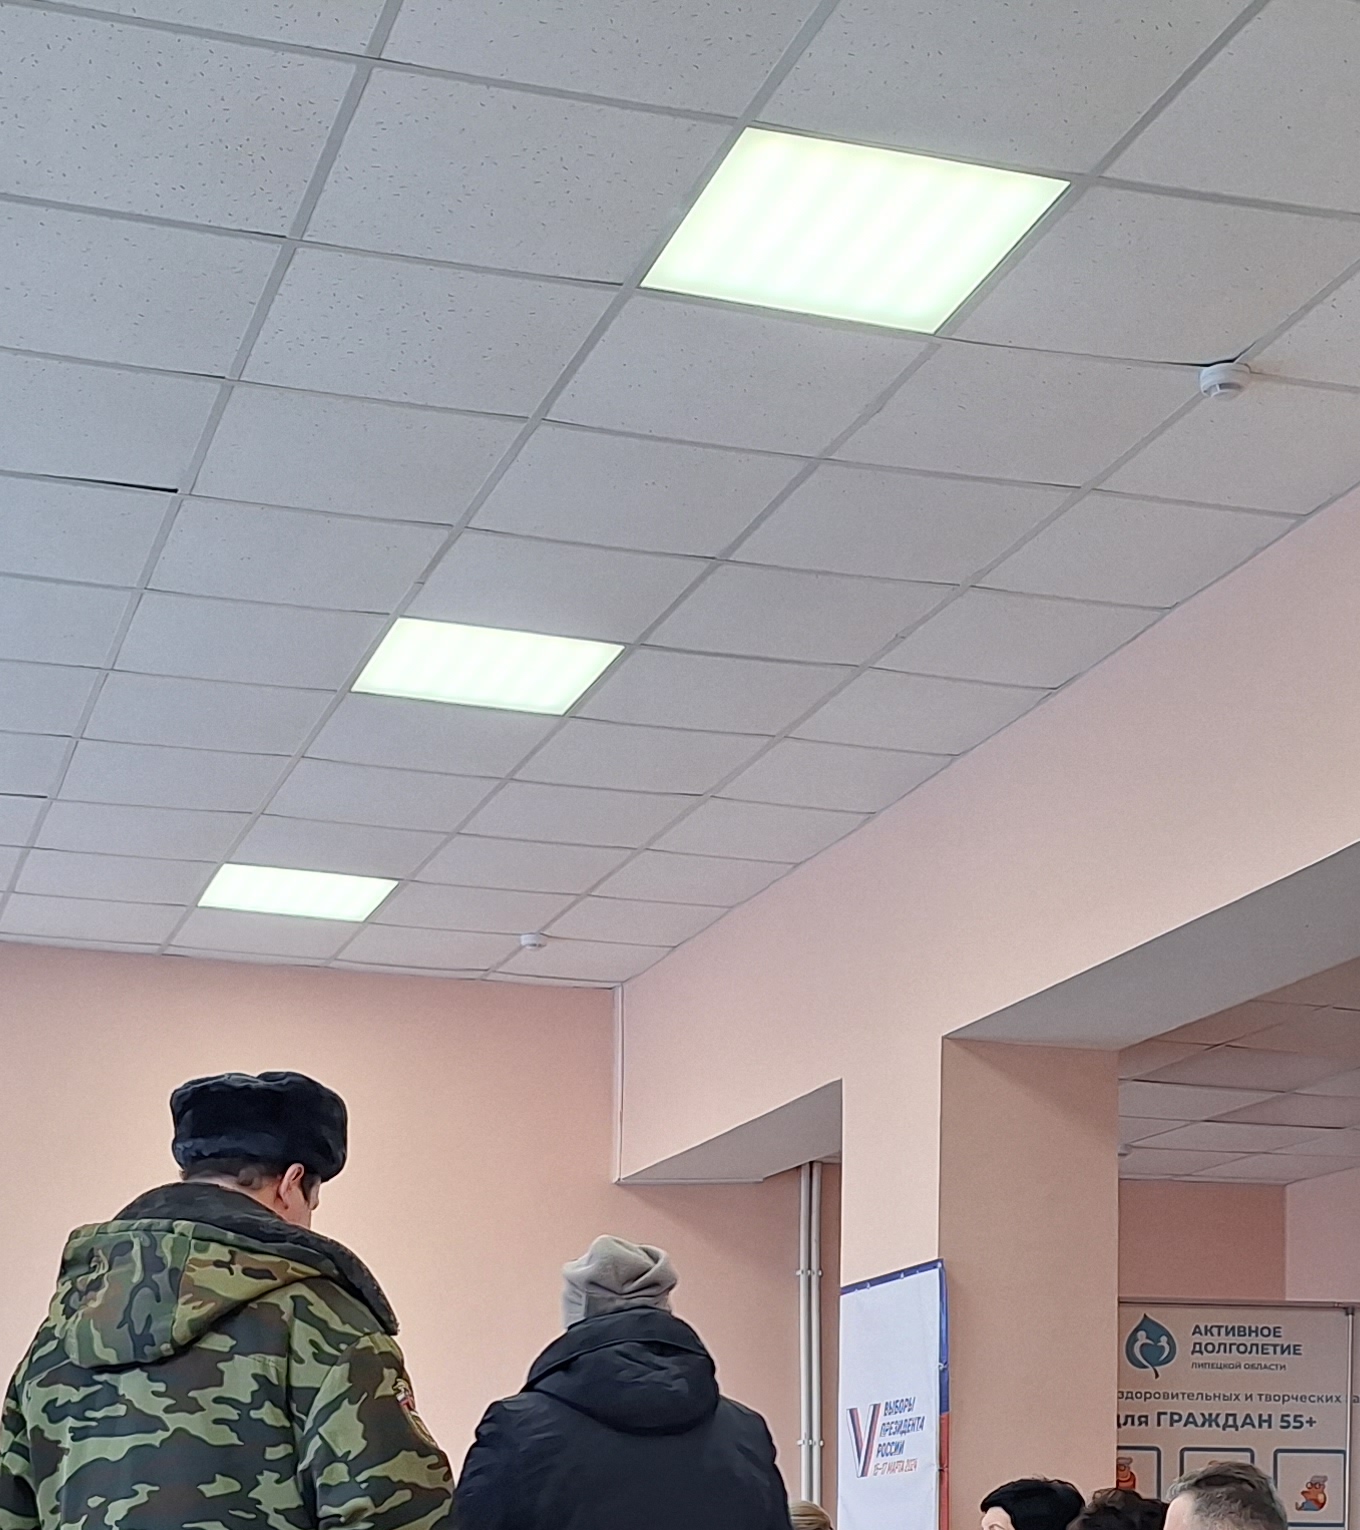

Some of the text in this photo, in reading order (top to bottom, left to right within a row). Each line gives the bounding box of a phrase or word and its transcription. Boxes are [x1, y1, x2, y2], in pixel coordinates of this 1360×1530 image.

[1191, 1324, 1282, 1338] АКТИВНОЕ
[1191, 1342, 1302, 1356] ДОЛГОЛЕТИЕ
[1191, 1361, 1287, 1372] ЛИПЕЦКОЙ ОБЛАСТИ
[1117, 1390, 1241, 1403] здоровительных
[1244, 1393, 1253, 1402] и
[1257, 1393, 1342, 1405] творческих
[884, 1396, 916, 1416] ВЫБОРЫ
[880, 1416, 925, 1437] ПРЕЗИДЕНТА
[1157, 1411, 1273, 1431] ГРАЖДАН
[1279, 1413, 1317, 1430] 55+
[876, 1440, 905, 1458] РОССИИ
